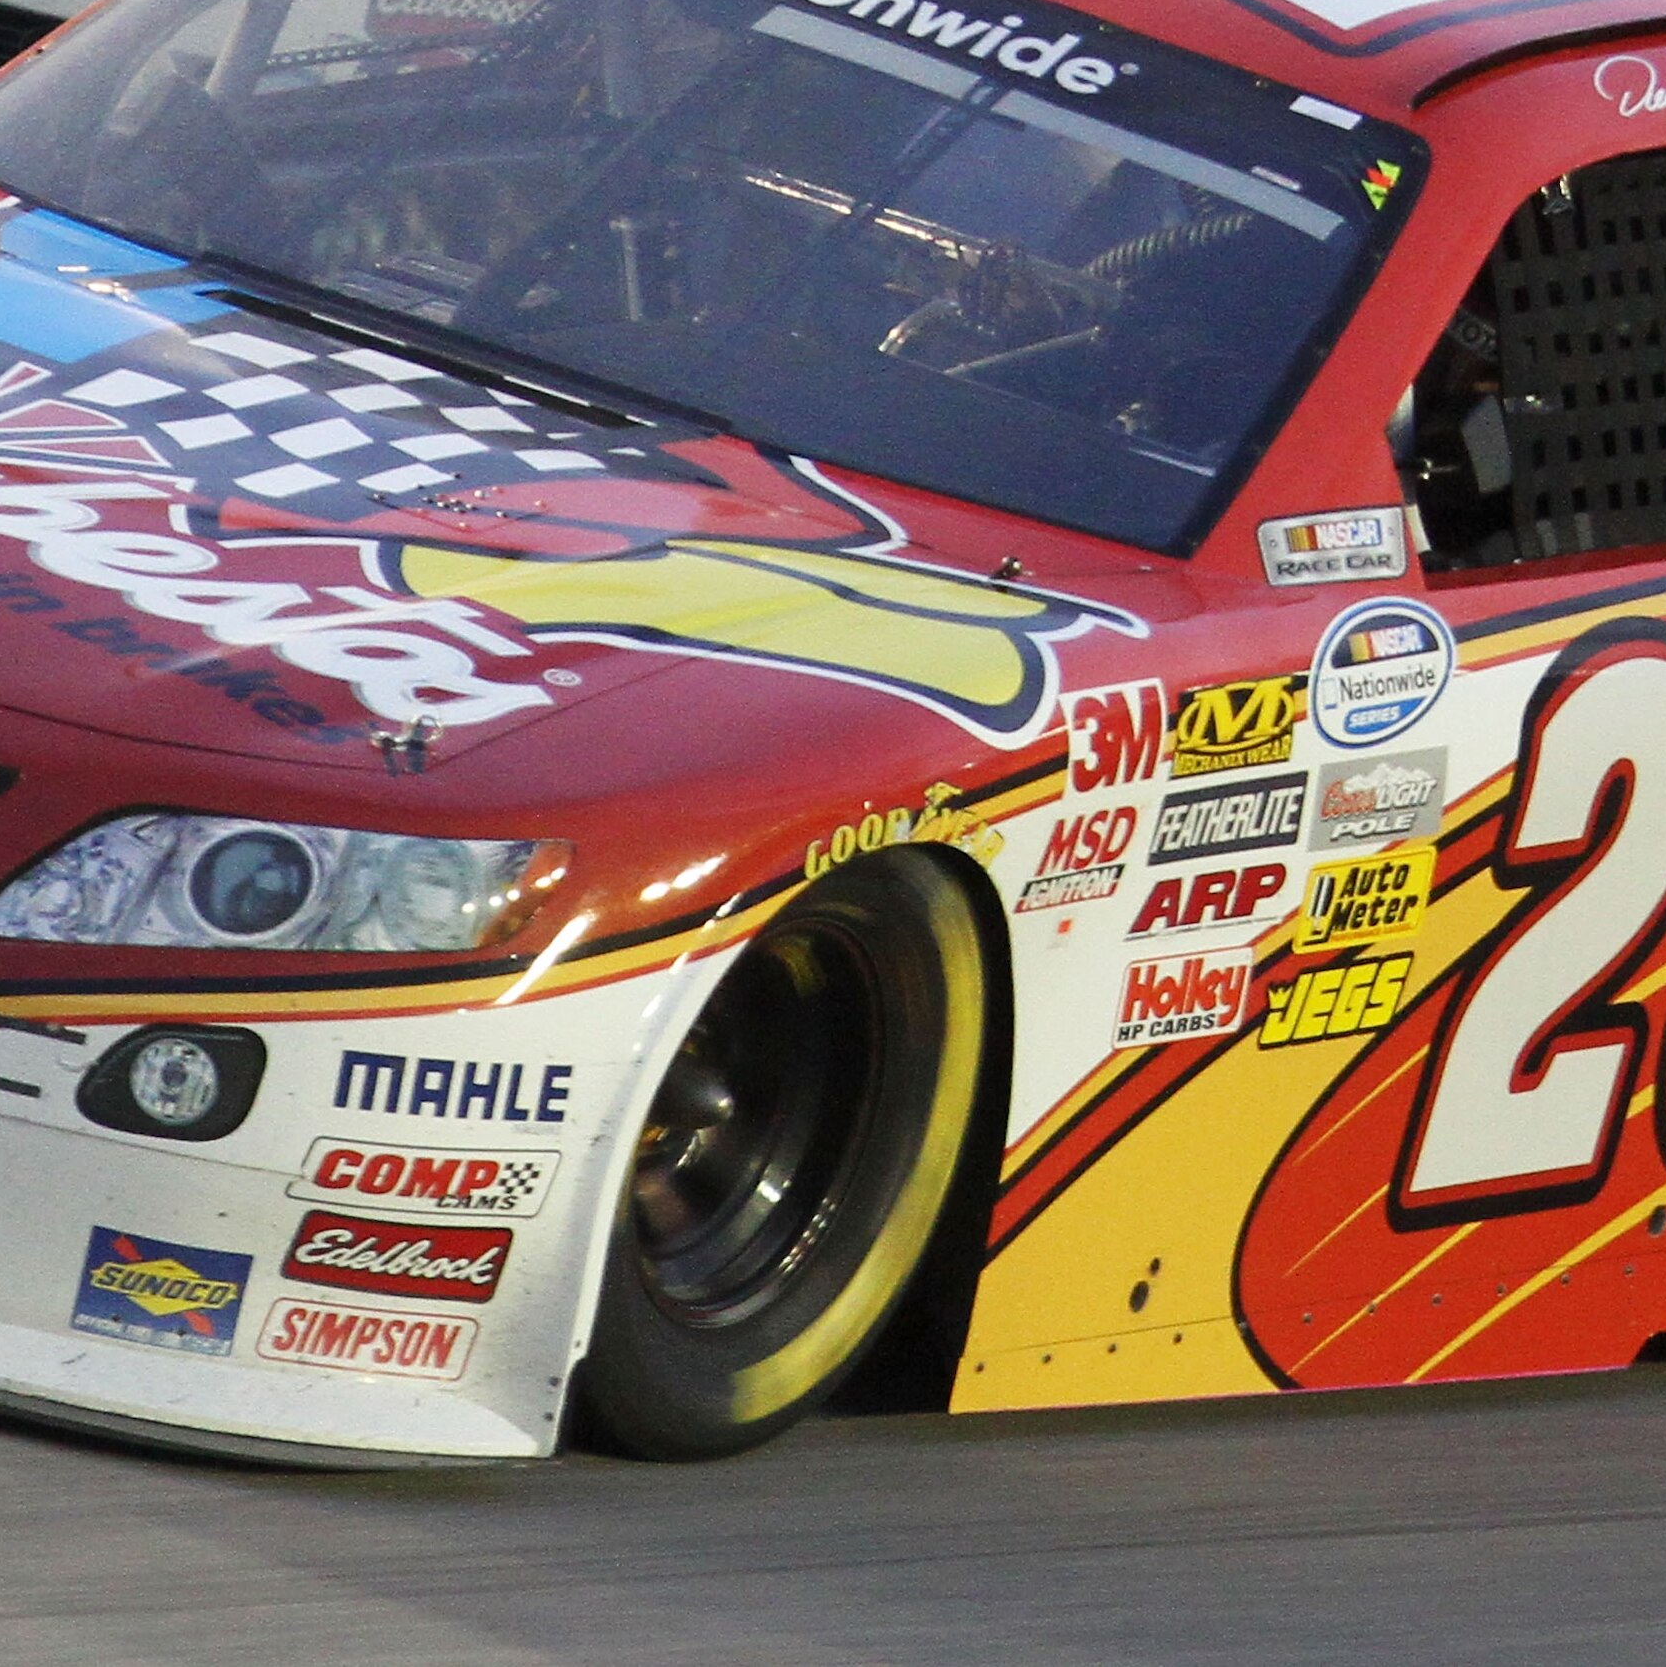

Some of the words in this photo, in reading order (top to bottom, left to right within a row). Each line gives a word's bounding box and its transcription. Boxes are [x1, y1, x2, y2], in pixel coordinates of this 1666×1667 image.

[1309, 519, 1384, 551] NASCAR
[1276, 556, 1335, 577] RACE
[1345, 551, 1396, 571] CAR
[1339, 660, 1437, 702] Nationwide
[1348, 703, 1401, 730] SERIES
[1069, 684, 1162, 794] 3M
[1246, 734, 1293, 763] WEAR
[1375, 779, 1438, 811] LIGHT
[1148, 784, 1306, 854] FEATHERLITE
[1330, 812, 1417, 842] POLE
[1036, 805, 1139, 876] MSD
[1021, 871, 1121, 910] IGNITION
[1127, 862, 1287, 934] ARP
[1341, 860, 1410, 899] Auto
[1332, 891, 1420, 932] Meter
[1121, 956, 1248, 1029] Holley
[1265, 958, 1409, 1043] JEGS
[1117, 1022, 1145, 1042] HP
[1149, 1015, 1217, 1036] CARBS
[334, 1049, 574, 1123] MAHLE
[313, 1148, 501, 1201] COMP
[435, 1190, 520, 1212] CAMS
[294, 1228, 498, 1286] Edelbrock
[96, 1264, 231, 1306] SUNOCO
[272, 1306, 462, 1371] SIMPSON
